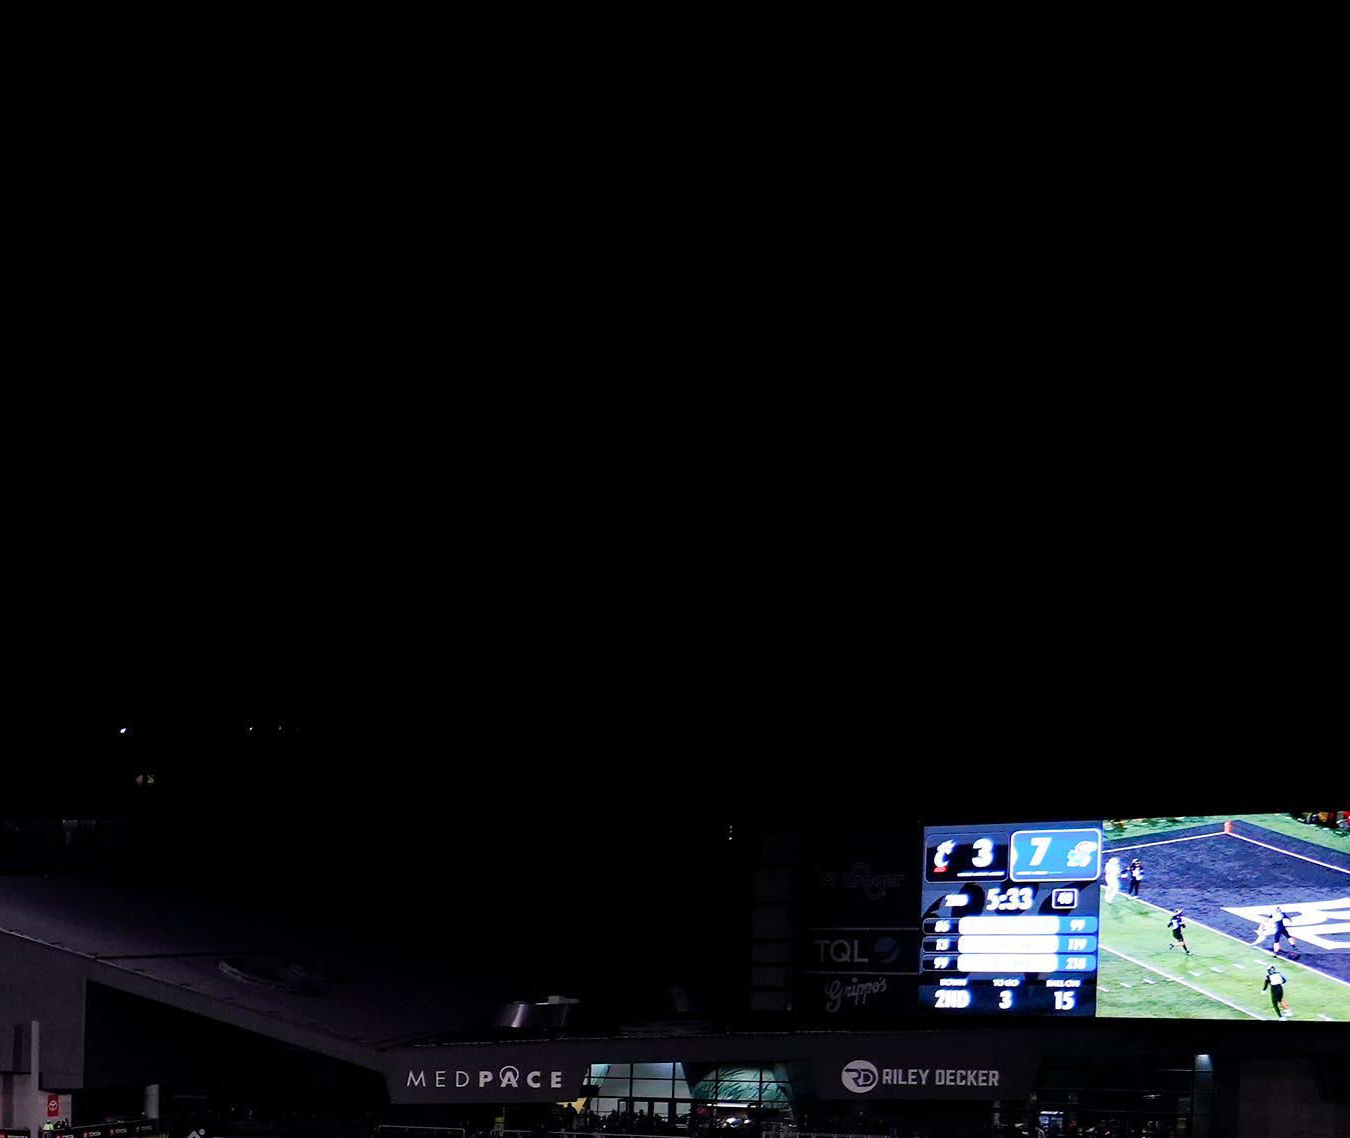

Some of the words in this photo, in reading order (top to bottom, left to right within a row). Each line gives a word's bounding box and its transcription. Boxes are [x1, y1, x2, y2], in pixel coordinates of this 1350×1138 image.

[972, 838, 994, 868] 3
[1030, 837, 1052, 867] 7
[986, 888, 1033, 911] 5:33
[814, 939, 868, 962] TQL
[824, 977, 888, 1013] Grippo's
[935, 990, 971, 1009] 2ND
[999, 990, 1013, 1009] 3
[1054, 990, 1075, 1011] 15
[406, 1065, 564, 1089] MEDPACE
[882, 1068, 931, 1087] RILEY
[935, 1070, 1000, 1088] DECKER
